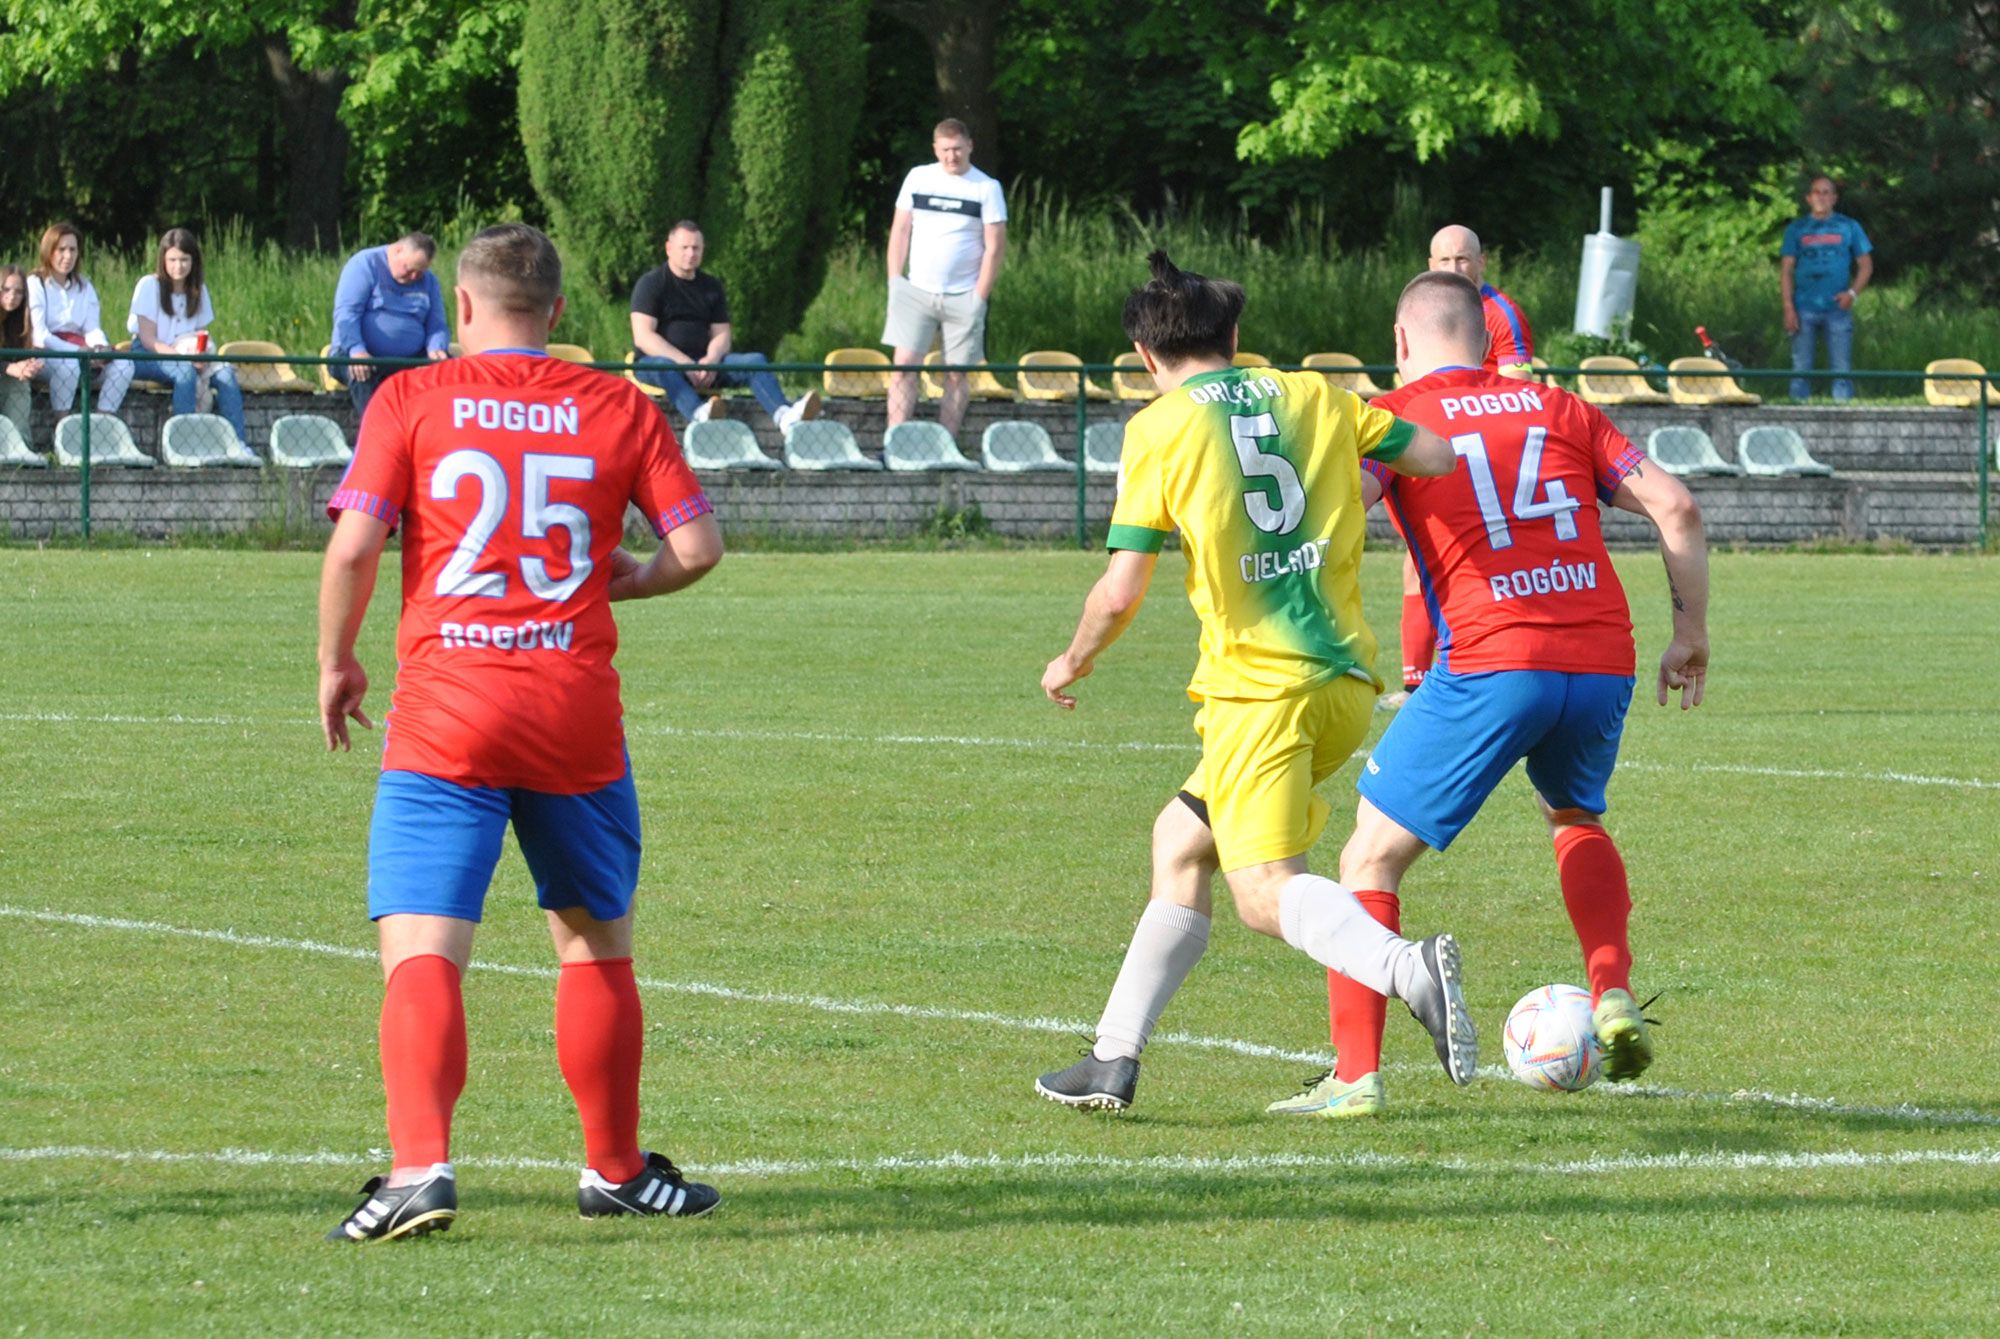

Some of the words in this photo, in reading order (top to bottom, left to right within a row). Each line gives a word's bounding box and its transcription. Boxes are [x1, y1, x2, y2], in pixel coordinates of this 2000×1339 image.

[453, 397, 579, 435] POGOŃ
[1441, 388, 1543, 419] POGOŃ
[1229, 412, 1306, 536] 5
[1450, 426, 1580, 550] 14
[431, 449, 595, 603] 25
[1490, 560, 1596, 601] ROGÓW
[440, 620, 574, 651] ROGÓW
